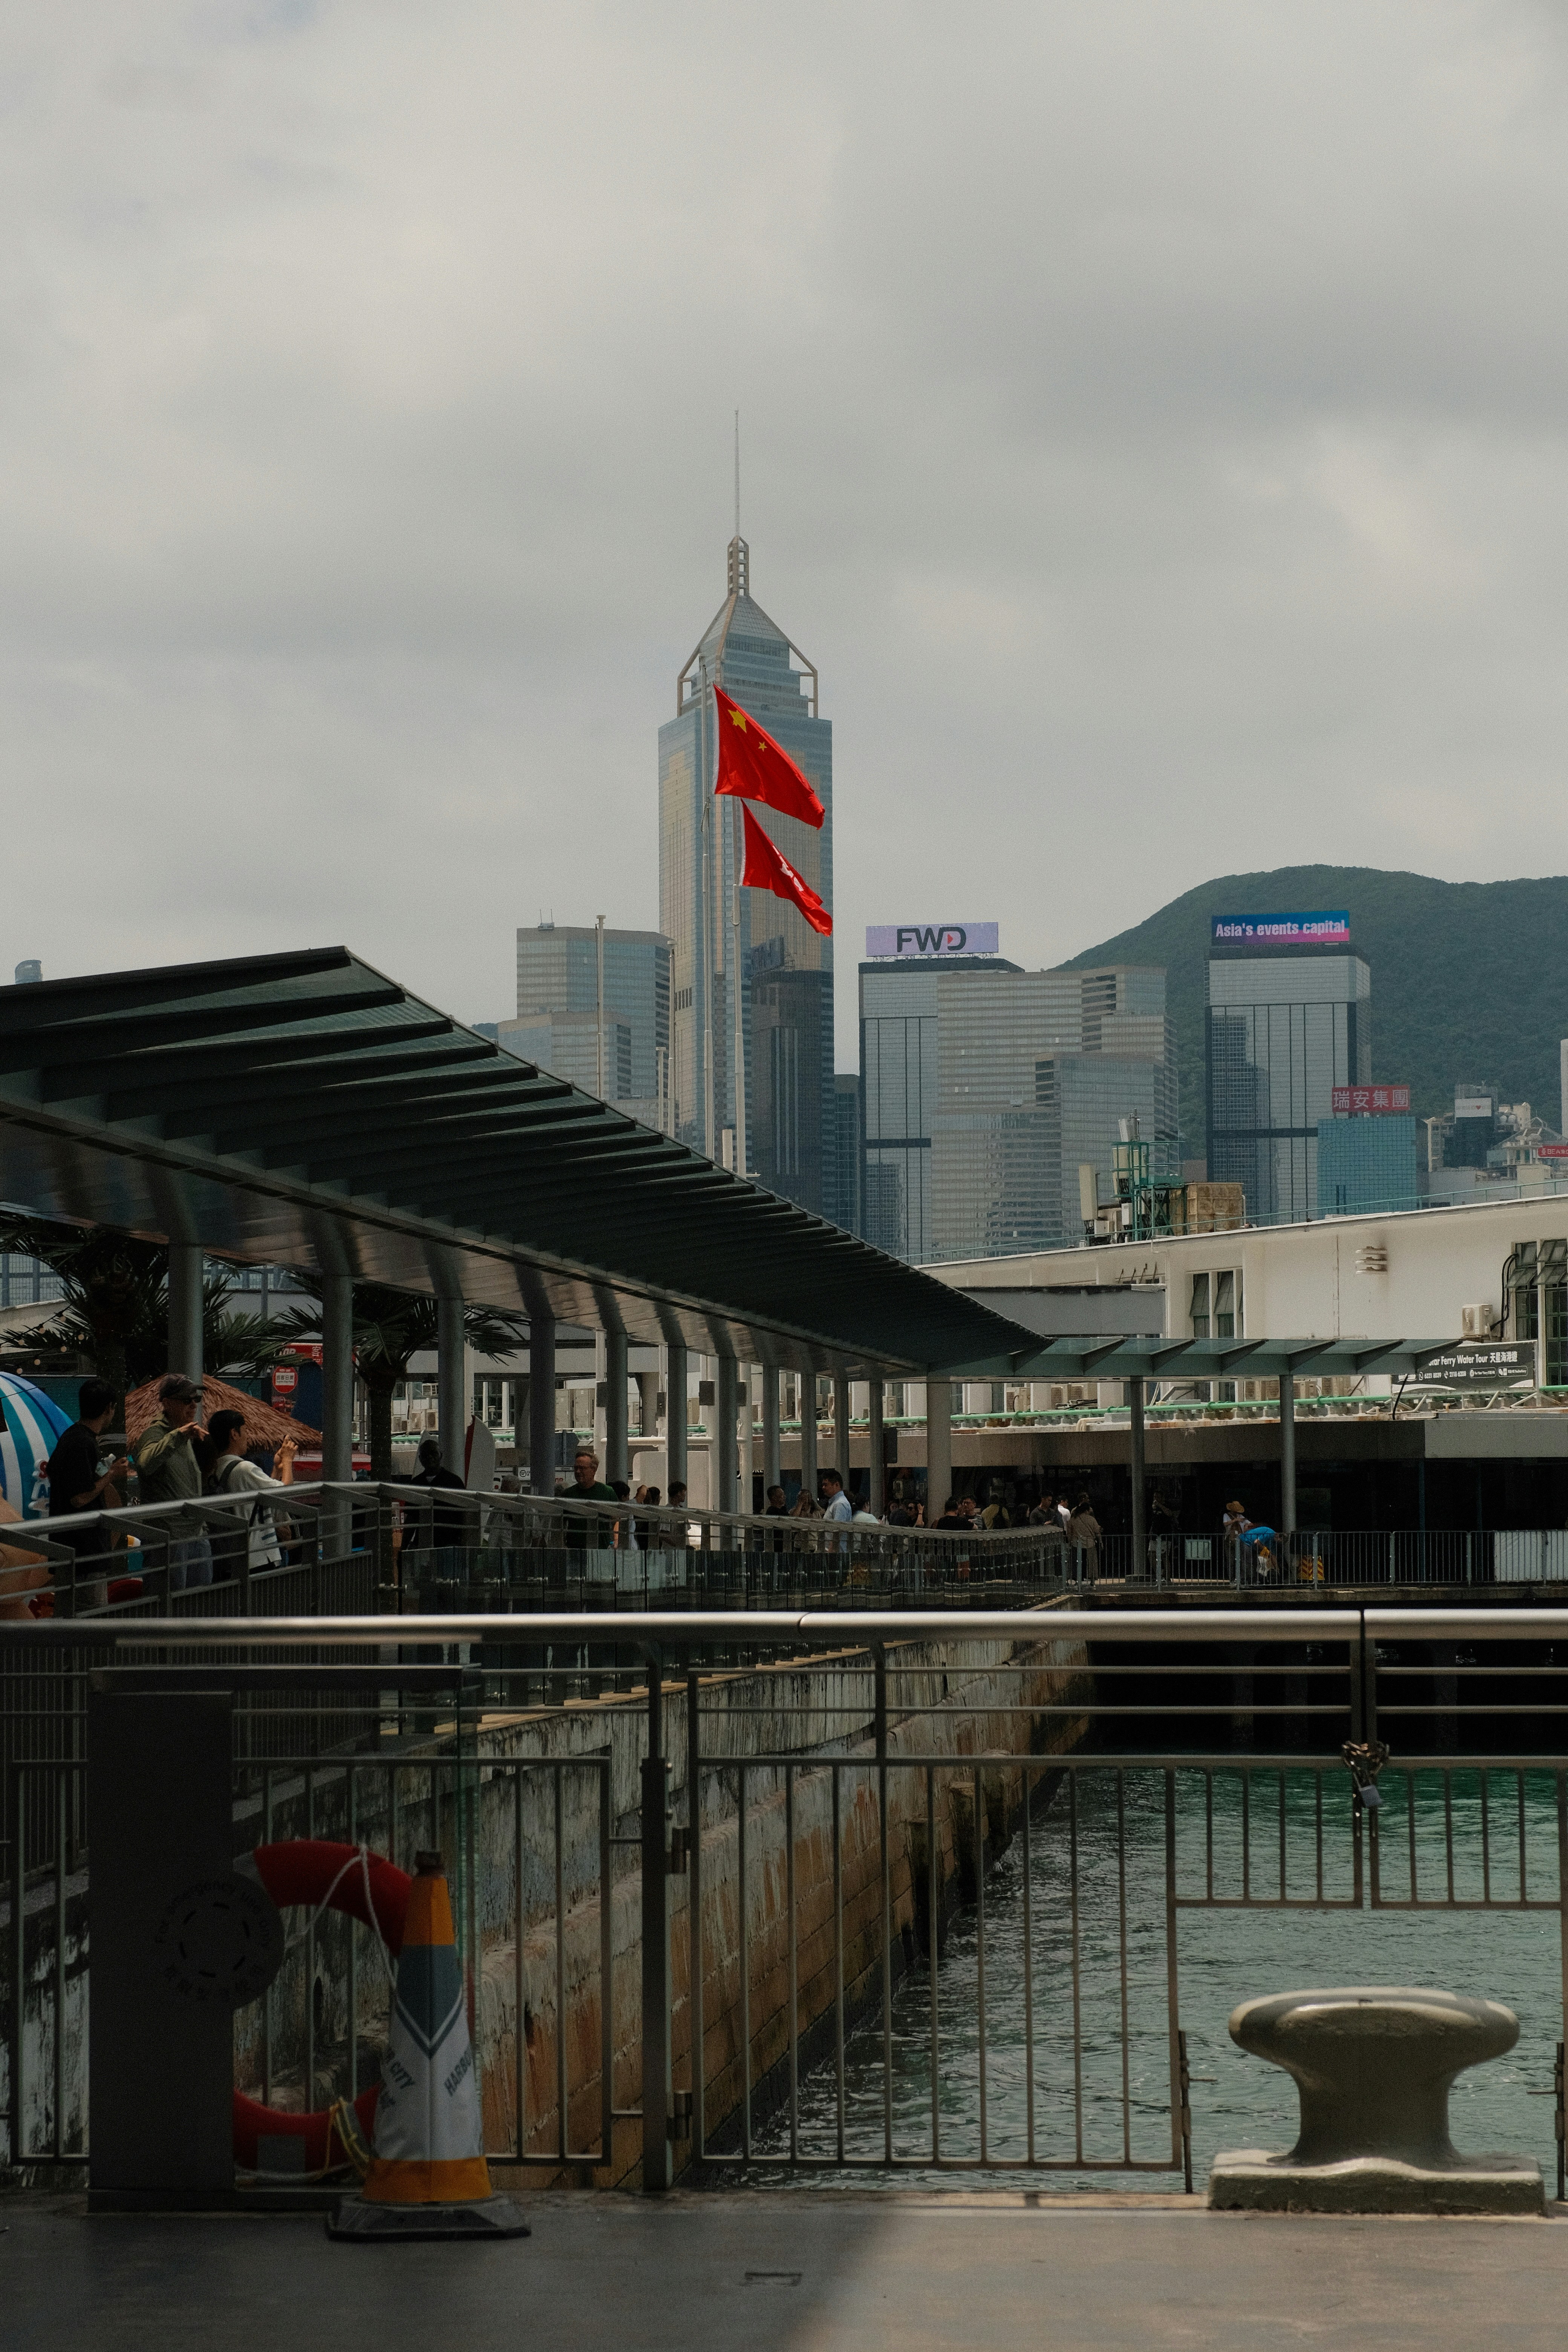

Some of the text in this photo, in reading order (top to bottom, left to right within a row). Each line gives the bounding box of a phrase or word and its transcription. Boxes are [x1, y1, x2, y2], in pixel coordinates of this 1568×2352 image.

[1216, 920, 1345, 937] Asia's events capital
[897, 926, 966, 952] FWD
[1333, 1089, 1408, 1109] 瑞安集團
[1441, 1356, 1456, 1367] Ferry
[1457, 1354, 1474, 1364] Water
[1475, 1354, 1488, 1363] Tour
[1490, 1351, 1517, 1363] 天星海港遊
[389, 2061, 415, 2089] CITY
